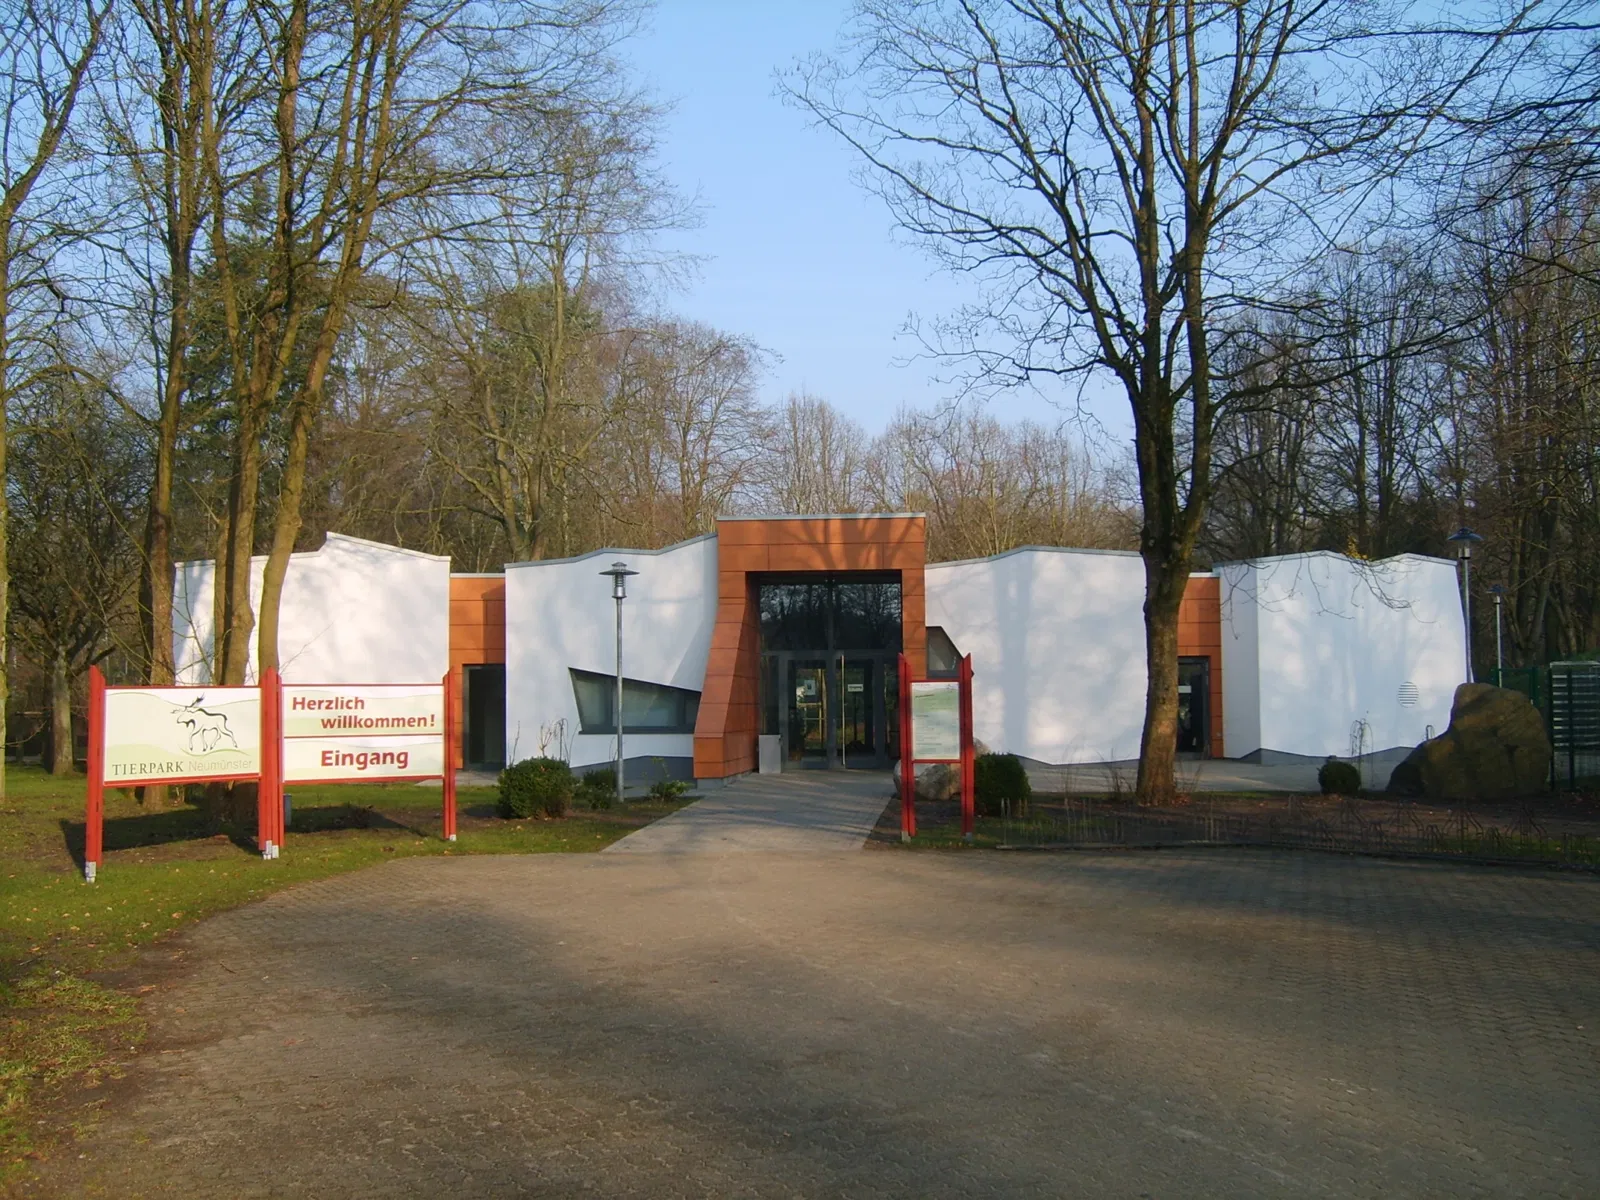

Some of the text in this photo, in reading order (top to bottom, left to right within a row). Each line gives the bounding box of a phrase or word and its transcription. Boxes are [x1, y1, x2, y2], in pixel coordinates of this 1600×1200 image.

[292, 697, 365, 710] Herzlich
[321, 714, 435, 729] willkommen!
[112, 759, 252, 776] TIERPARK Neumünster
[321, 750, 408, 770] Eingang
